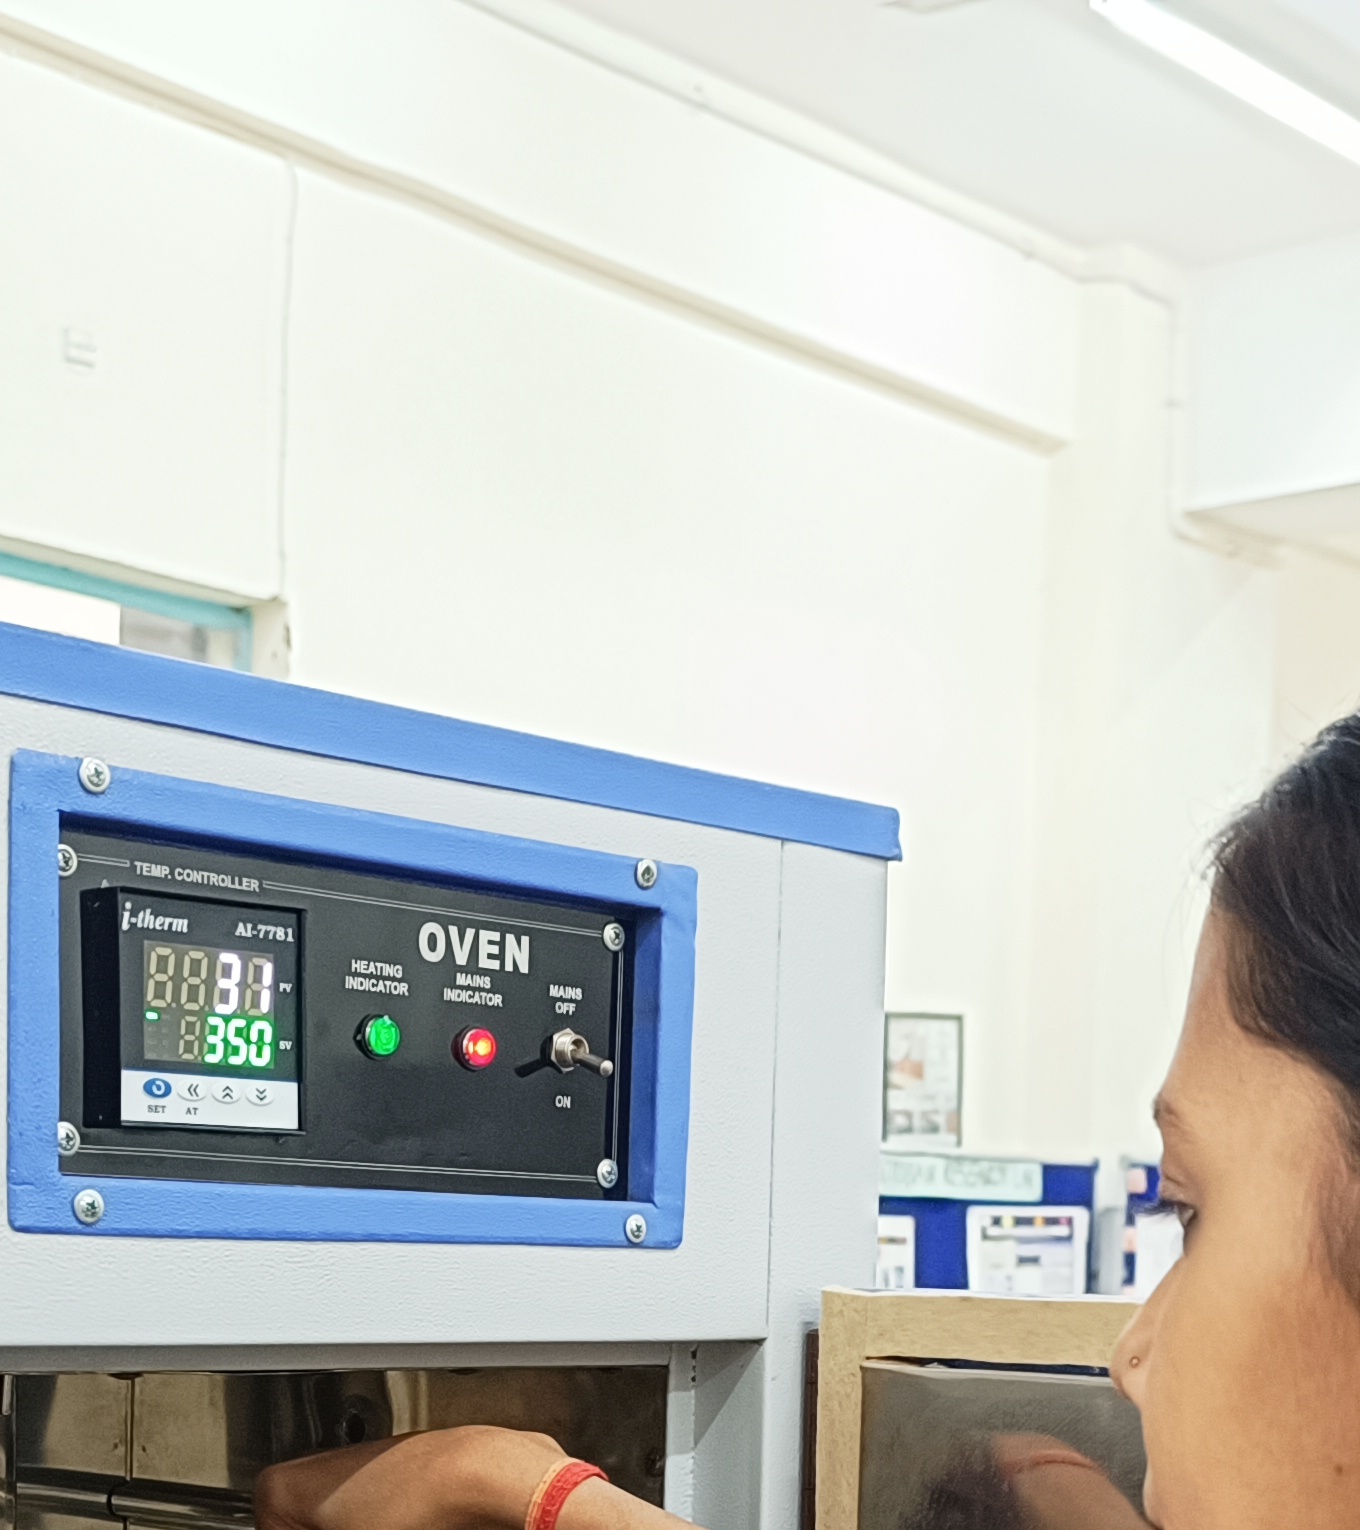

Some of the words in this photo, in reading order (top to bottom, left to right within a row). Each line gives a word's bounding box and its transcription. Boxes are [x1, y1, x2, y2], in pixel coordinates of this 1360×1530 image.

[134, 861, 172, 880] TEMP.
[174, 867, 260, 892] CONTROLLER
[121, 901, 188, 933] i-therm
[235, 922, 295, 942] AI-7781
[418, 921, 530, 974] OVEN
[351, 959, 403, 978] HEATING
[214, 952, 273, 1015] 31
[279, 982, 292, 993] PV
[345, 975, 409, 996] INDICATOR
[456, 973, 491, 989] MAINS
[443, 988, 503, 1007] INDICATOR
[549, 984, 582, 1001] MAINS
[555, 1001, 576, 1016] OFF
[203, 1016, 273, 1067] 350
[147, 1104, 167, 1113] SET
[185, 1107, 199, 1116] AT
[555, 1095, 571, 1109] ON
